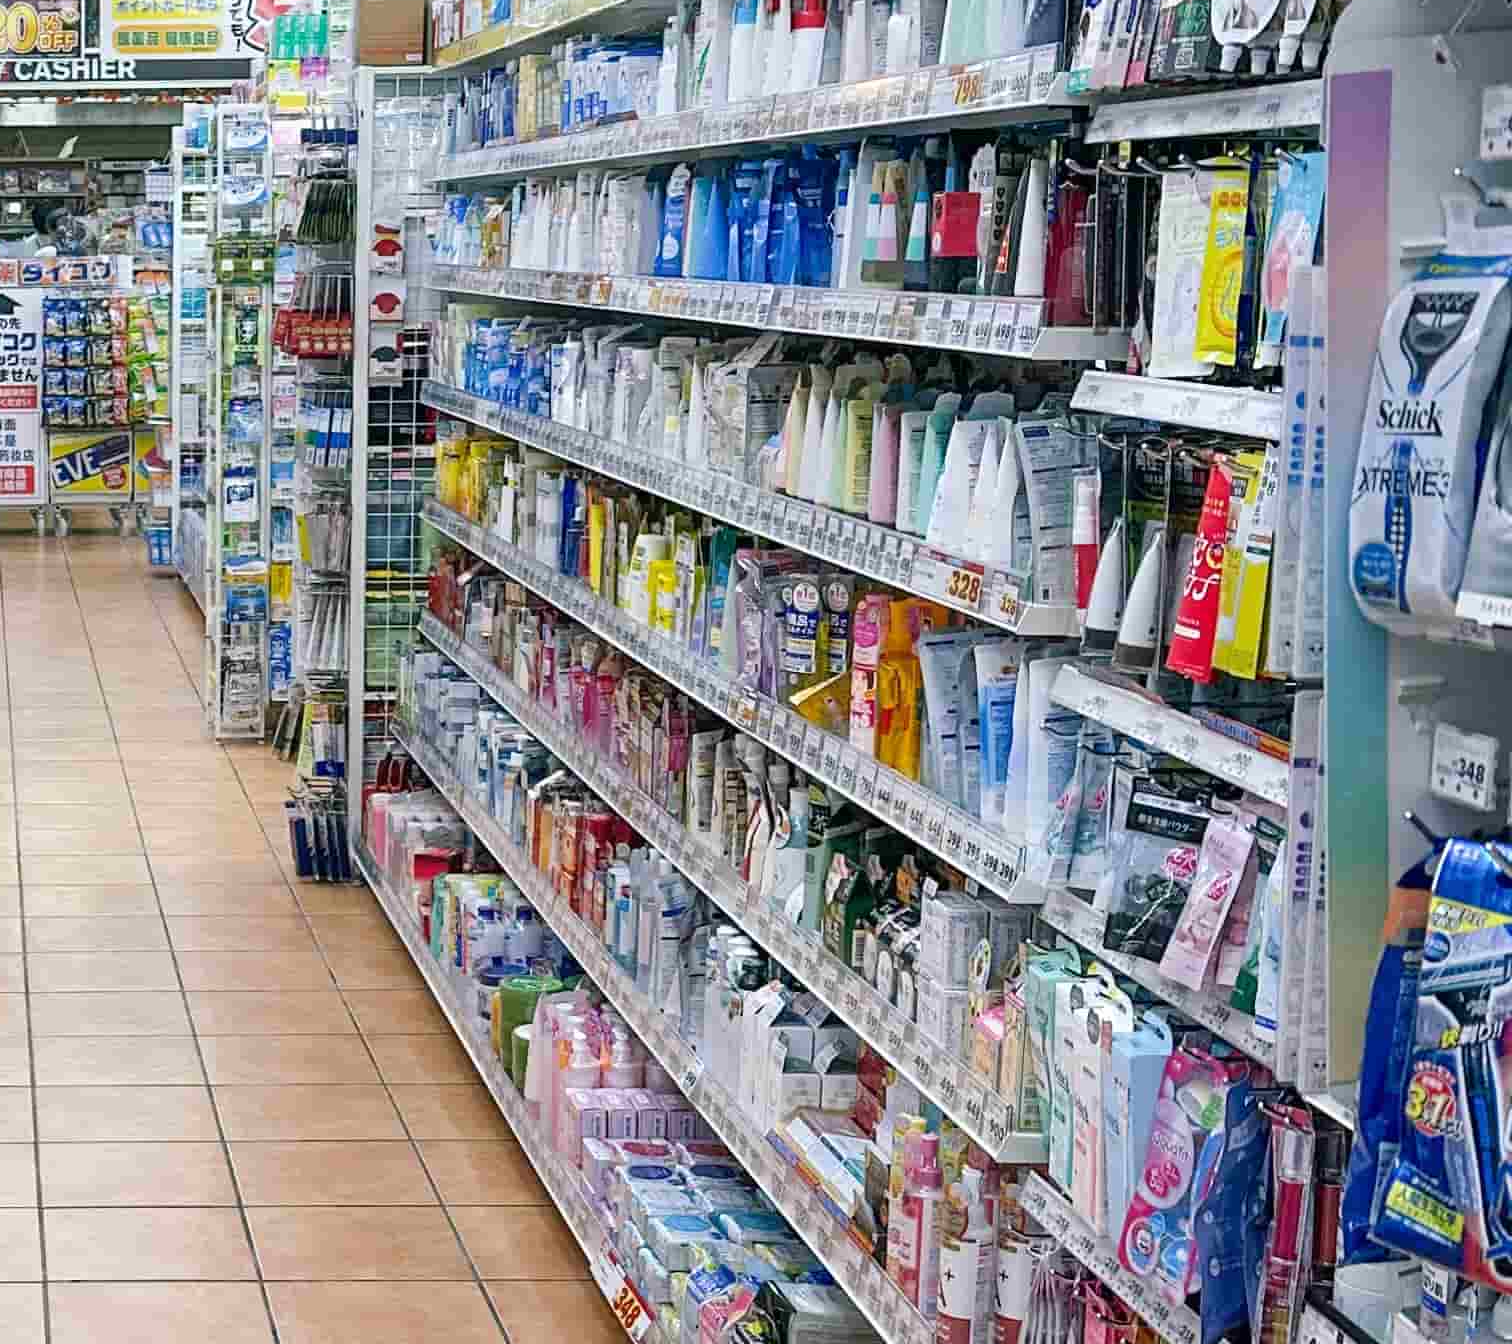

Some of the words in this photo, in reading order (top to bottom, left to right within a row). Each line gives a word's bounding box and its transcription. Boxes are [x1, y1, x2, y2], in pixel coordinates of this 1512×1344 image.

[40, 31, 78, 51] OFF
[15, 60, 136, 80] CASHIER
[1377, 400, 1442, 436] Schick
[51, 447, 102, 489] EVE
[949, 571, 980, 602] 328
[613, 1286, 641, 1329] 348
